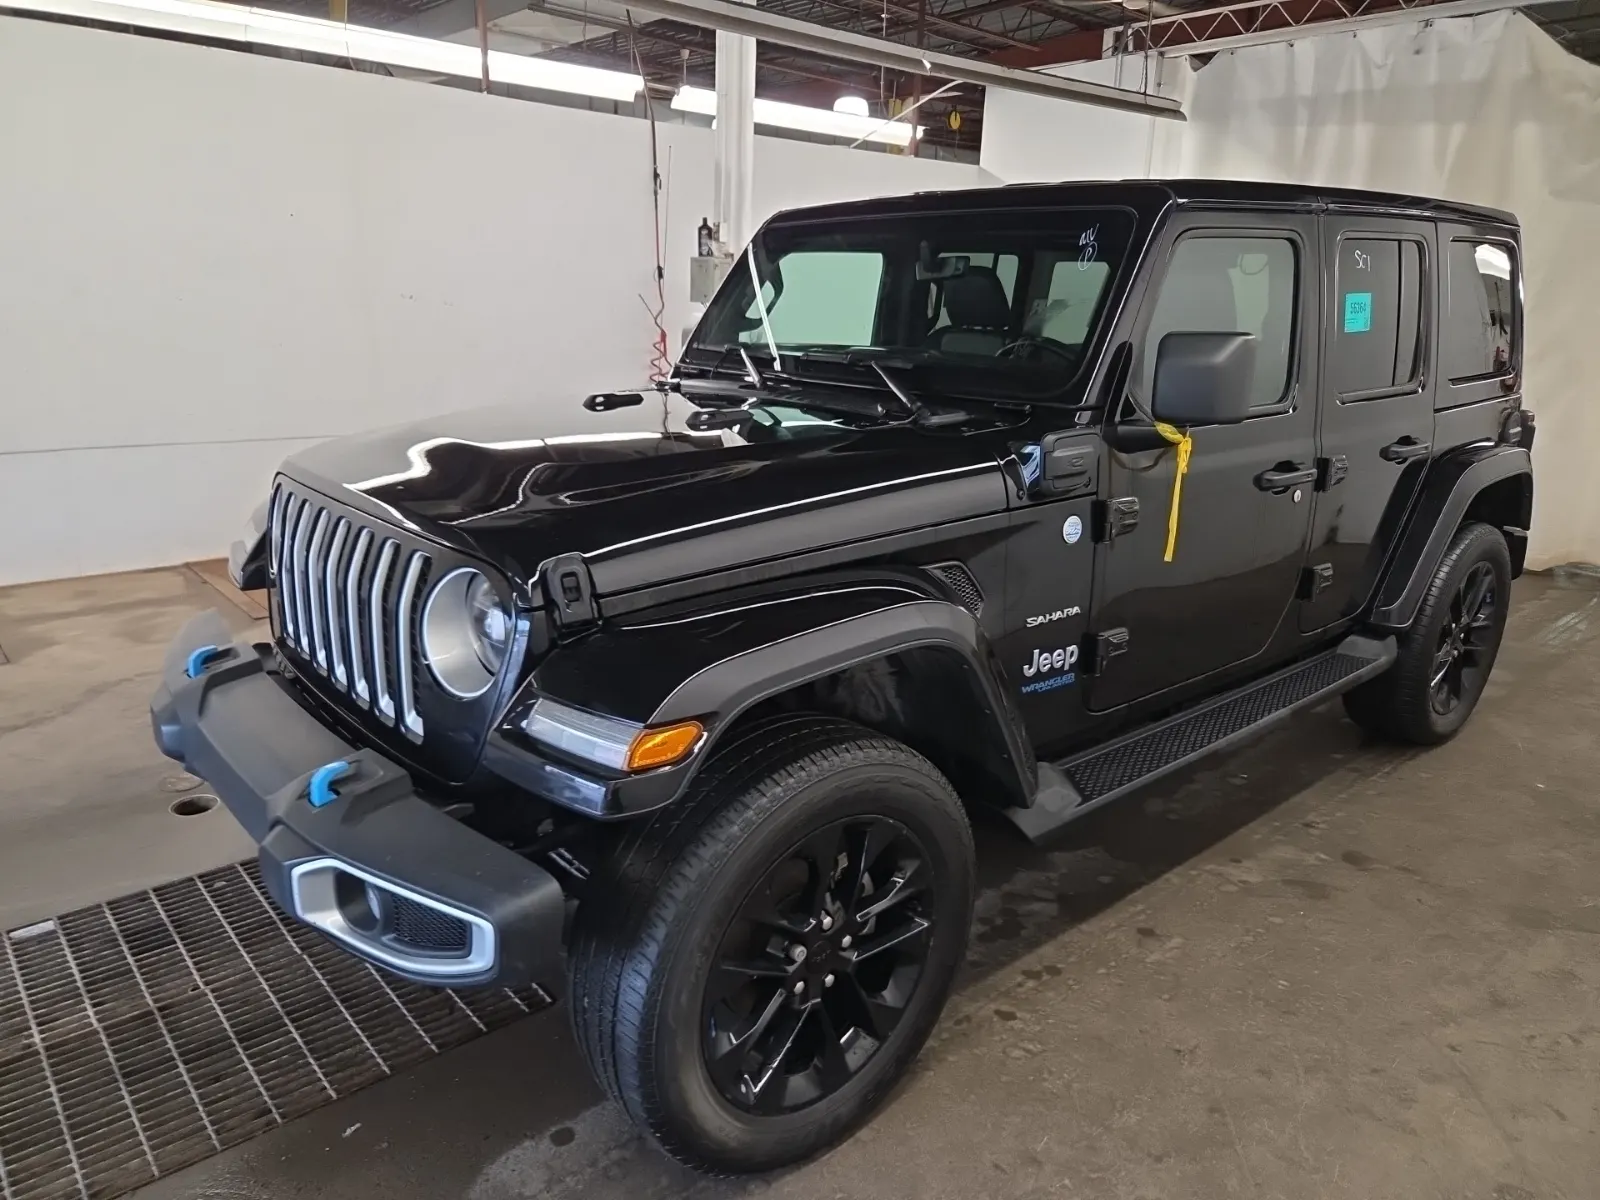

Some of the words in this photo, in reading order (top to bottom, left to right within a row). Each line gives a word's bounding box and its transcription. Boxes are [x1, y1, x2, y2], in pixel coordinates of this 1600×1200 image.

[1026, 606, 1081, 628] SAHARA
[1023, 644, 1079, 677] Jeep
[1022, 673, 1075, 693] WRANGLER
